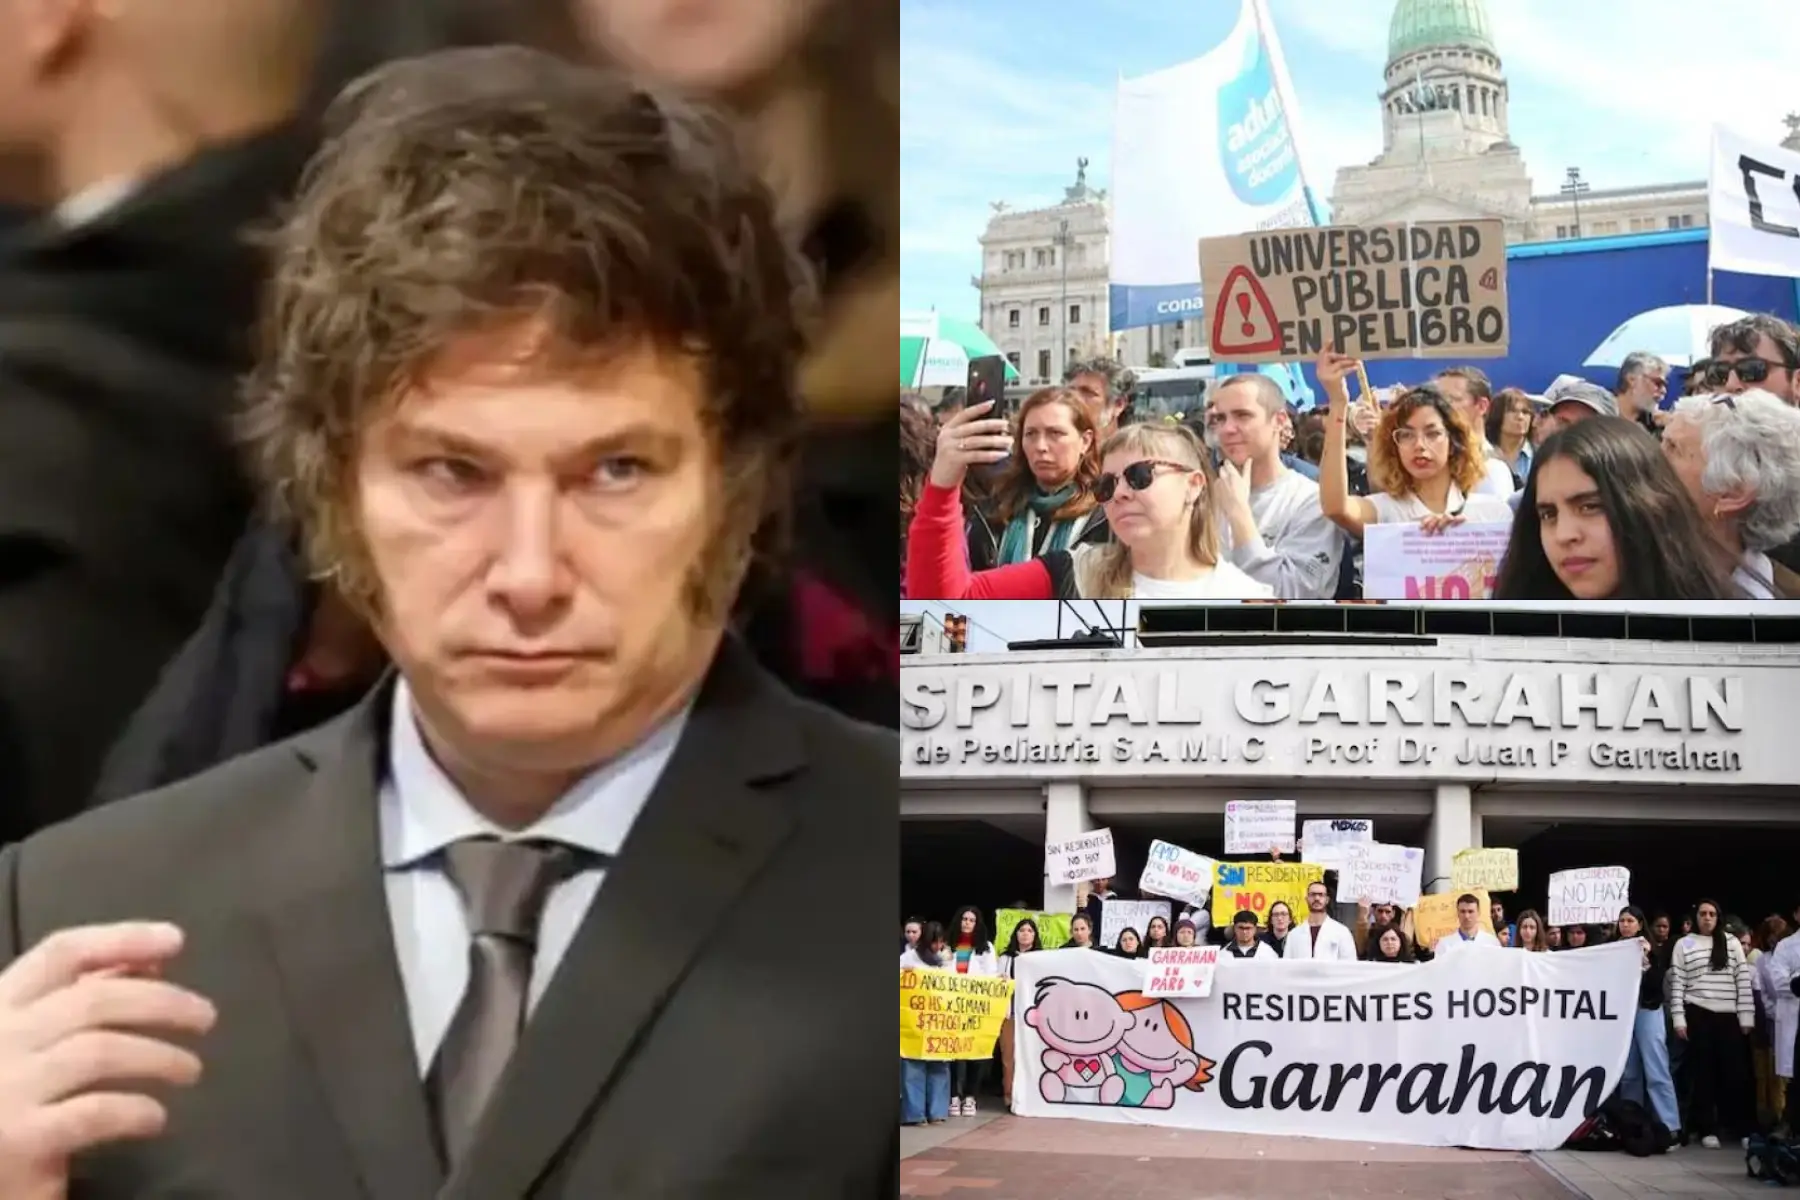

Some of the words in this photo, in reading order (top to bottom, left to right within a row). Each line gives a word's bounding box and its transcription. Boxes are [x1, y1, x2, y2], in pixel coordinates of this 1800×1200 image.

[1738, 154, 1800, 239] C
[1249, 225, 1481, 278] UNIVERSIDAD
[1292, 264, 1470, 316] PÚBLICA
[1280, 318, 1323, 355] EN
[1332, 305, 1503, 355] PELIGRO
[901, 672, 1202, 731] SPITAL
[1234, 668, 1743, 731] GARRAHAN
[916, 737, 950, 764] de
[1456, 738, 1537, 767] Juan
[1589, 742, 1743, 771] Garrahan
[1068, 856, 1080, 866] NO
[1217, 864, 1245, 887] SIN
[1354, 873, 1371, 882] NO
[1235, 892, 1266, 912] NO
[1563, 882, 1587, 906] NO
[1593, 881, 1626, 902] HAY
[1552, 906, 1617, 923] HOSPITAL
[1152, 950, 1217, 964] GARRAHAN
[1165, 967, 1179, 976] EN
[948, 976, 959, 992] DE
[1150, 977, 1185, 991] PARO
[1222, 992, 1433, 1022] RESIDENTES
[1447, 987, 1618, 1021] HOSPITAL
[1218, 1039, 1607, 1119] Garrahan
